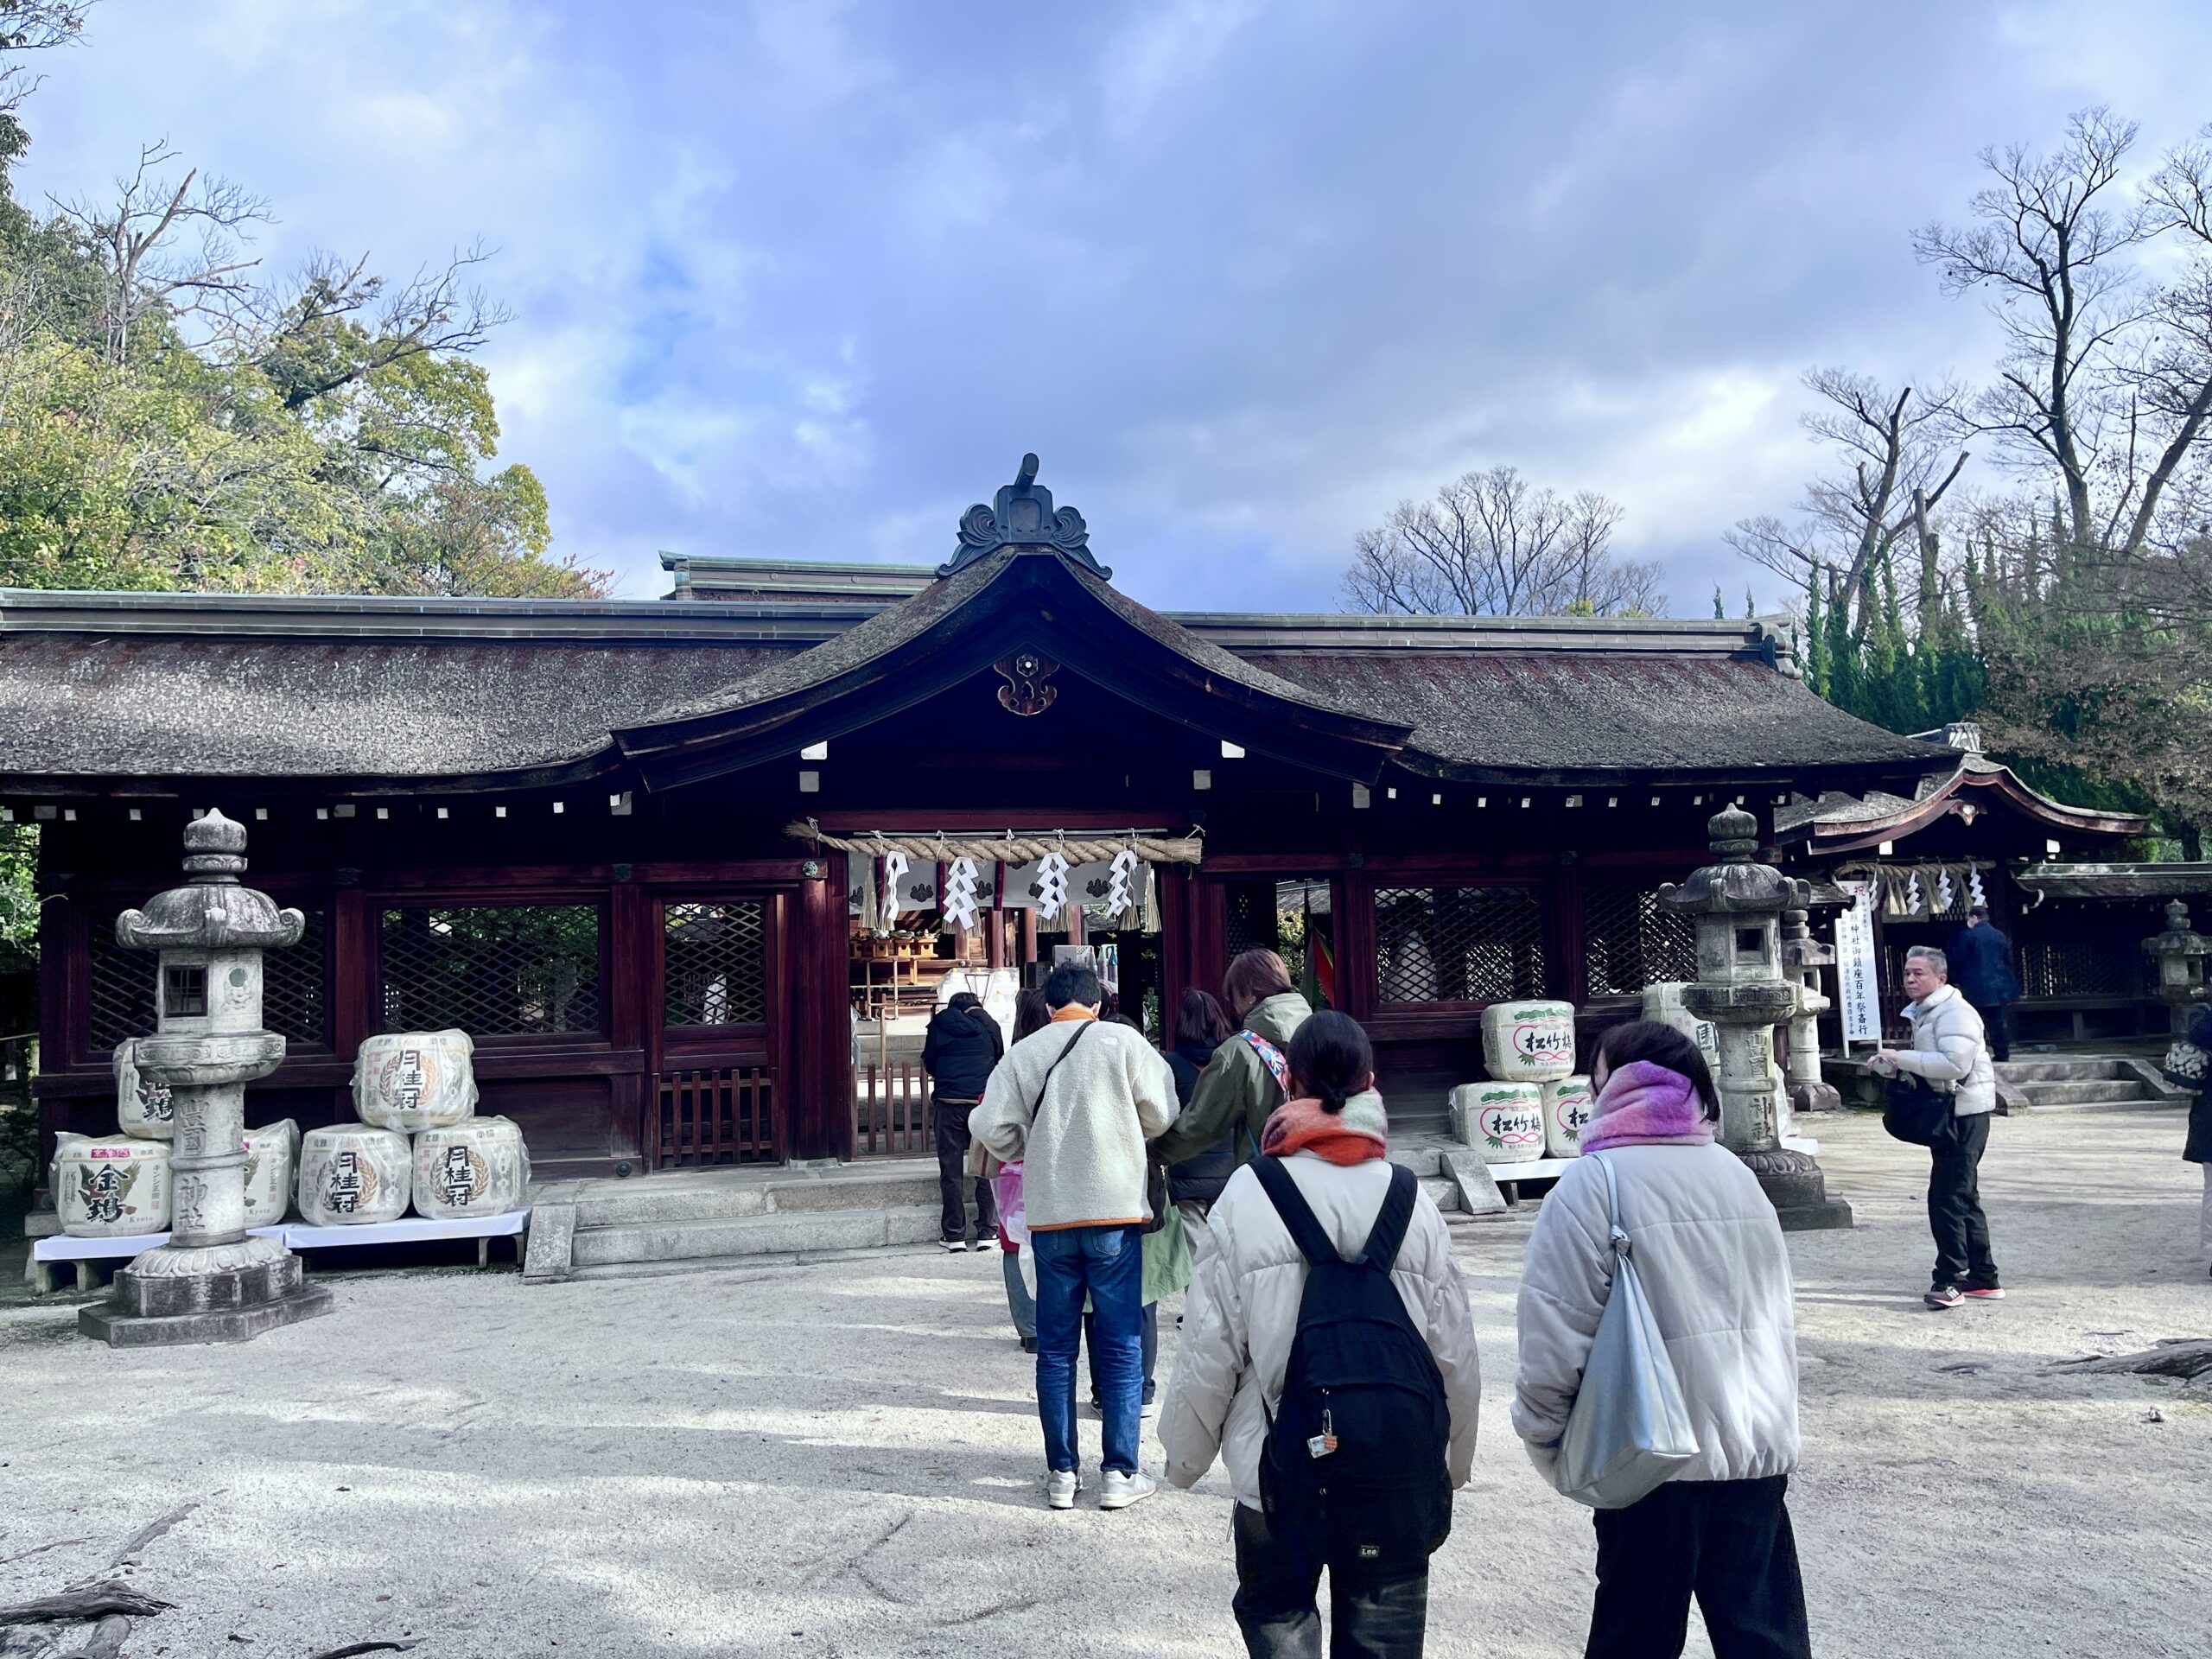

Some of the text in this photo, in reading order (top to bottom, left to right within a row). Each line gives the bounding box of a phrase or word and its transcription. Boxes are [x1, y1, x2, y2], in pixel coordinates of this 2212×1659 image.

[1525, 1032, 1572, 1052] 松竹梅
[395, 1050, 423, 1109] 月桂冠
[1492, 1113, 1541, 1135] 松竹梅
[330, 1152, 359, 1213] 月桂冠
[443, 1146, 473, 1207] 月桂冠
